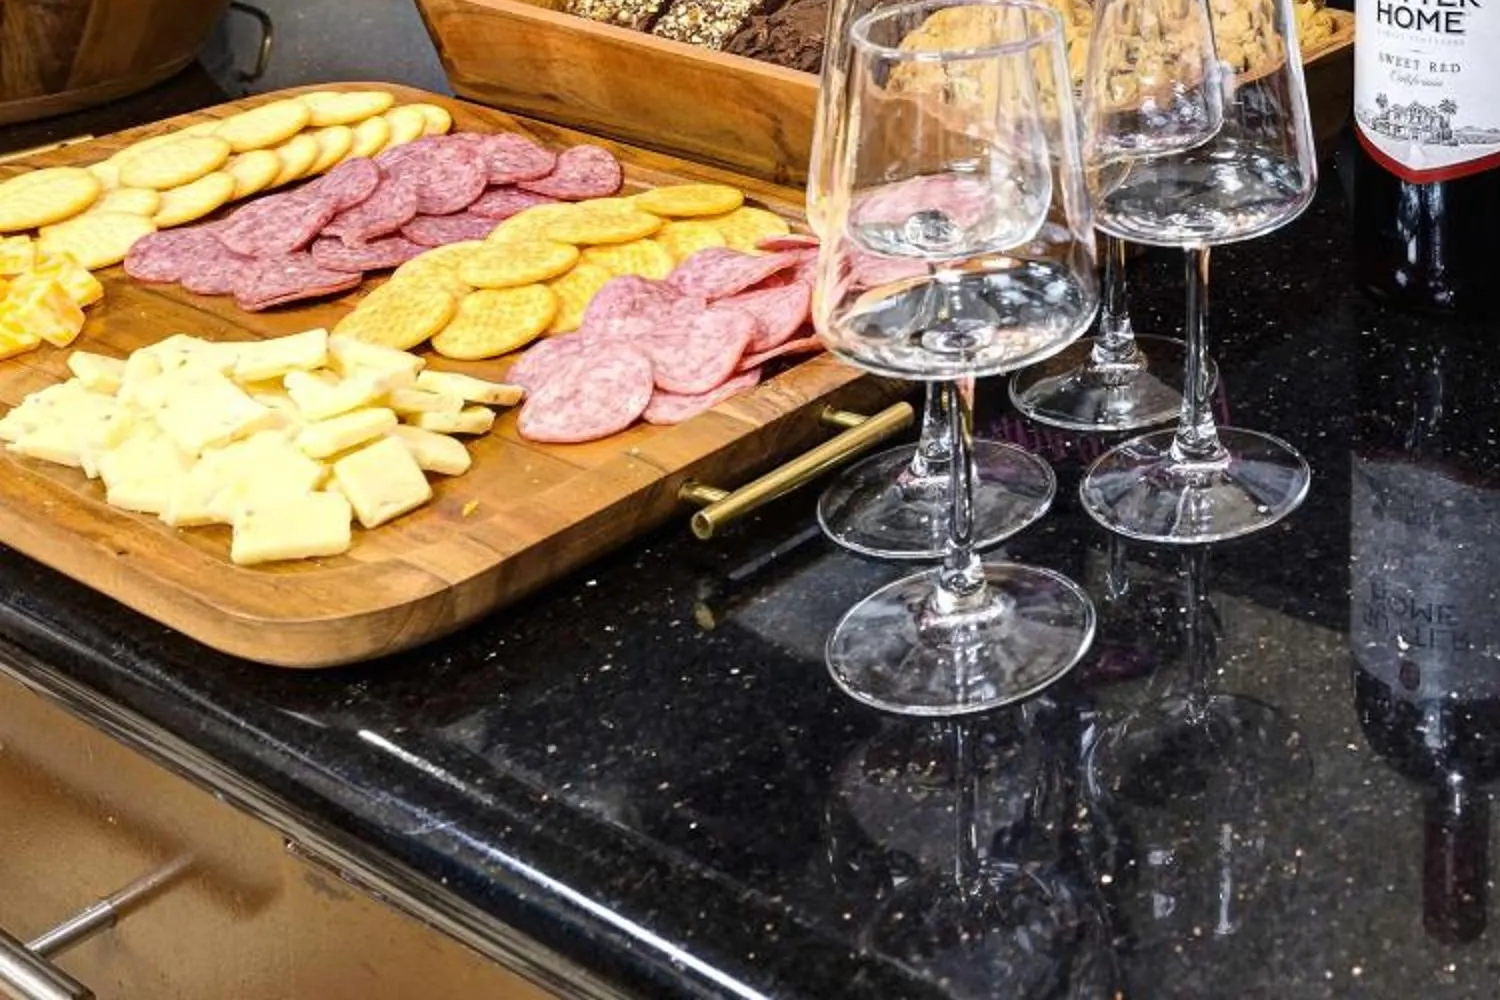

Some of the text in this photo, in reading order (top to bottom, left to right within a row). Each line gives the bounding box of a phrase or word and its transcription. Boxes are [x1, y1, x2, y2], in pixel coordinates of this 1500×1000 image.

[1376, 0, 1466, 35] HOME
[1378, 51, 1462, 75] SWEET RED
